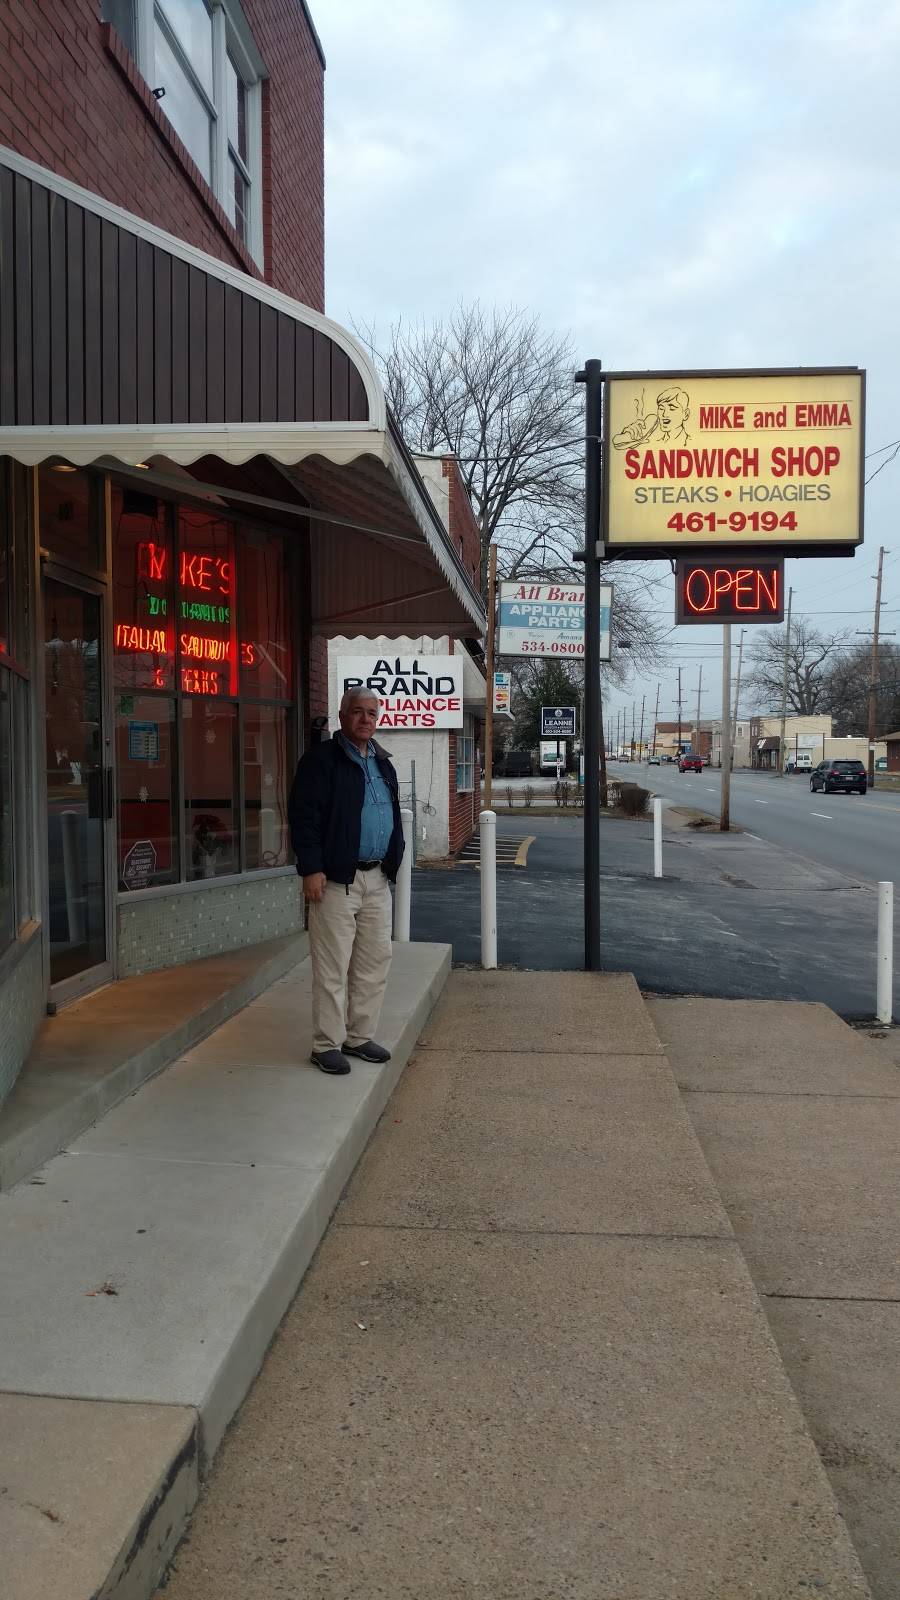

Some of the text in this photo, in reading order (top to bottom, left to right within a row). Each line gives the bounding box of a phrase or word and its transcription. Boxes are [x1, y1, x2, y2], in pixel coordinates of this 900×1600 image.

[699, 403, 852, 430] MIKE and EMMA
[625, 446, 841, 480] SANDWICH SHOP
[634, 483, 831, 504] STEAKS HOAGIES
[666, 511, 798, 533] 461-9194
[149, 543, 230, 594] MKE'S
[513, 585, 585, 602] All Bra
[686, 568, 778, 611] OPEN
[509, 604, 601, 619] APPLIAN
[528, 616, 581, 628] PARTS
[180, 634, 254, 664] SANDWIES
[521, 640, 585, 654] 534-0800
[372, 657, 429, 676] ALL
[343, 676, 456, 696] BRAND
[378, 698, 461, 712] PLIANCE
[378, 713, 436, 727] ARTS
